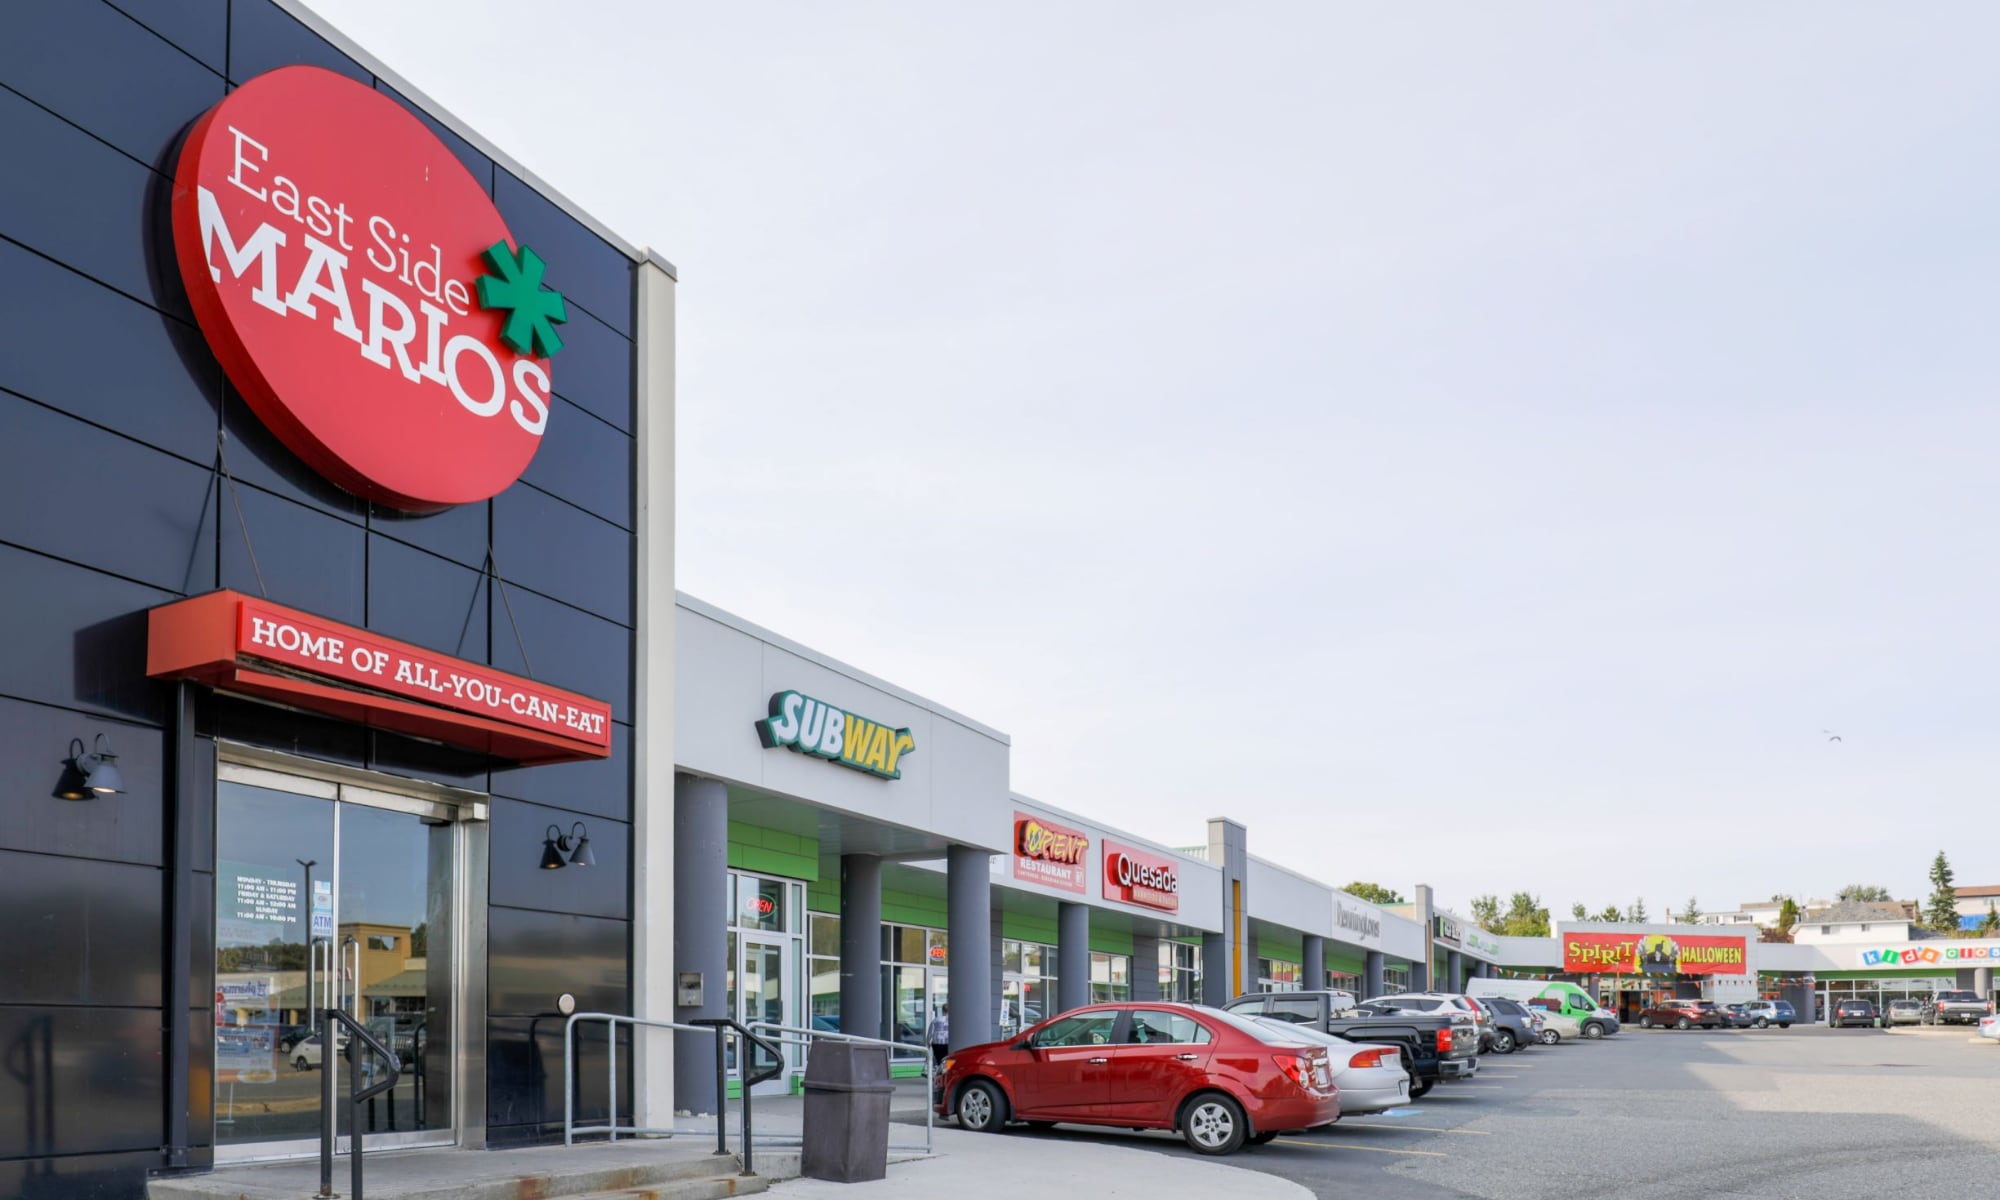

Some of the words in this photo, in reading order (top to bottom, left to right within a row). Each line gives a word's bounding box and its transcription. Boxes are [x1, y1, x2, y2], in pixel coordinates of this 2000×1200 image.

[227, 125, 353, 251] East
[366, 215, 470, 317] Side
[197, 185, 551, 436] MARIOS
[252, 616, 344, 664] HOME
[351, 646, 390, 676] OF
[394, 659, 606, 735] ALL-YOU-CAN-EAT
[771, 692, 914, 774] SUBWAY
[1024, 820, 1089, 865] ORIENT
[1020, 858, 1072, 880] RESTAURANT
[1118, 852, 1178, 893] Quesada
[313, 915, 332, 929] ATM
[746, 897, 773, 913] OPEN
[930, 946, 946, 959] OPEN
[1568, 941, 1634, 965] SPIRIT
[1682, 945, 1742, 964] HALLOWEEN
